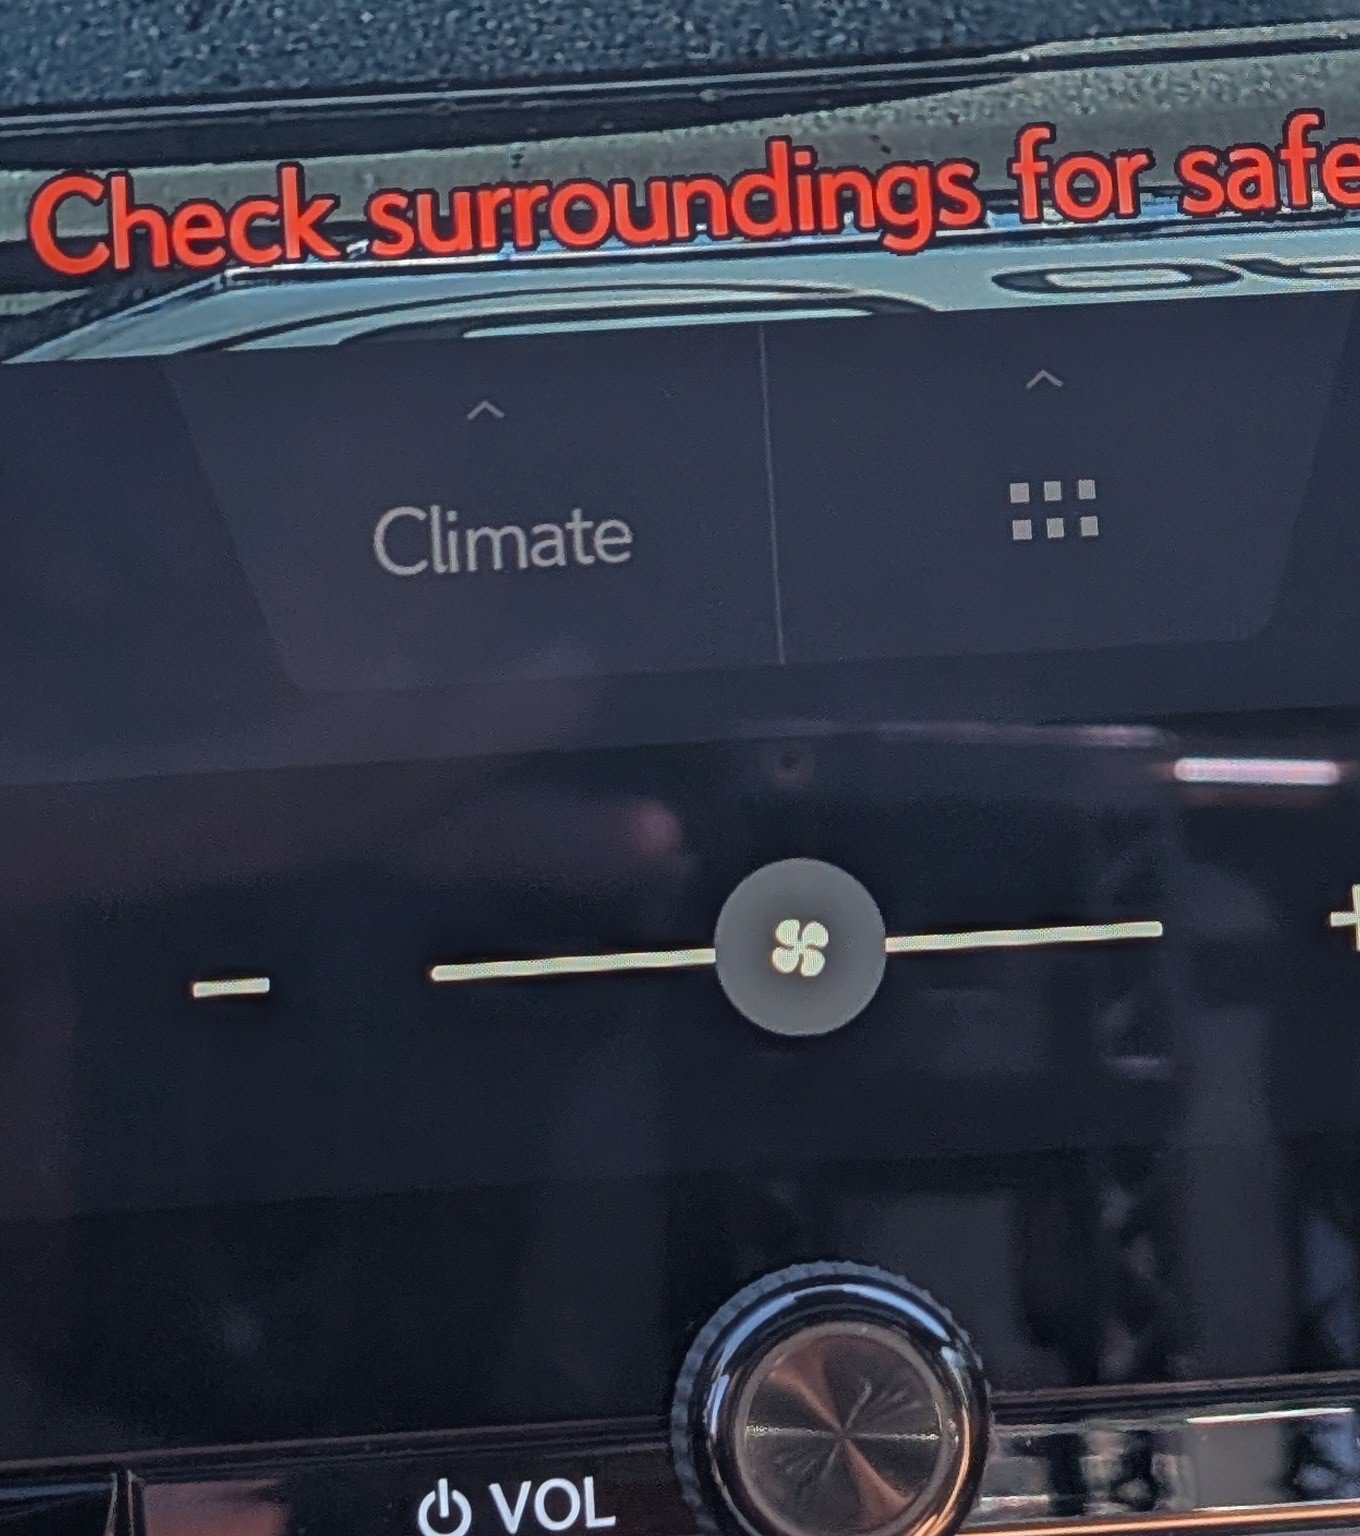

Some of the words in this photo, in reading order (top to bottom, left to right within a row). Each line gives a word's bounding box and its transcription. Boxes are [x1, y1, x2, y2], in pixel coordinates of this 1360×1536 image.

[28, 164, 339, 275] Check
[367, 139, 983, 253] surroundings
[1010, 124, 1151, 222] for
[371, 503, 634, 577] Climate
[488, 1474, 618, 1535] VOL
